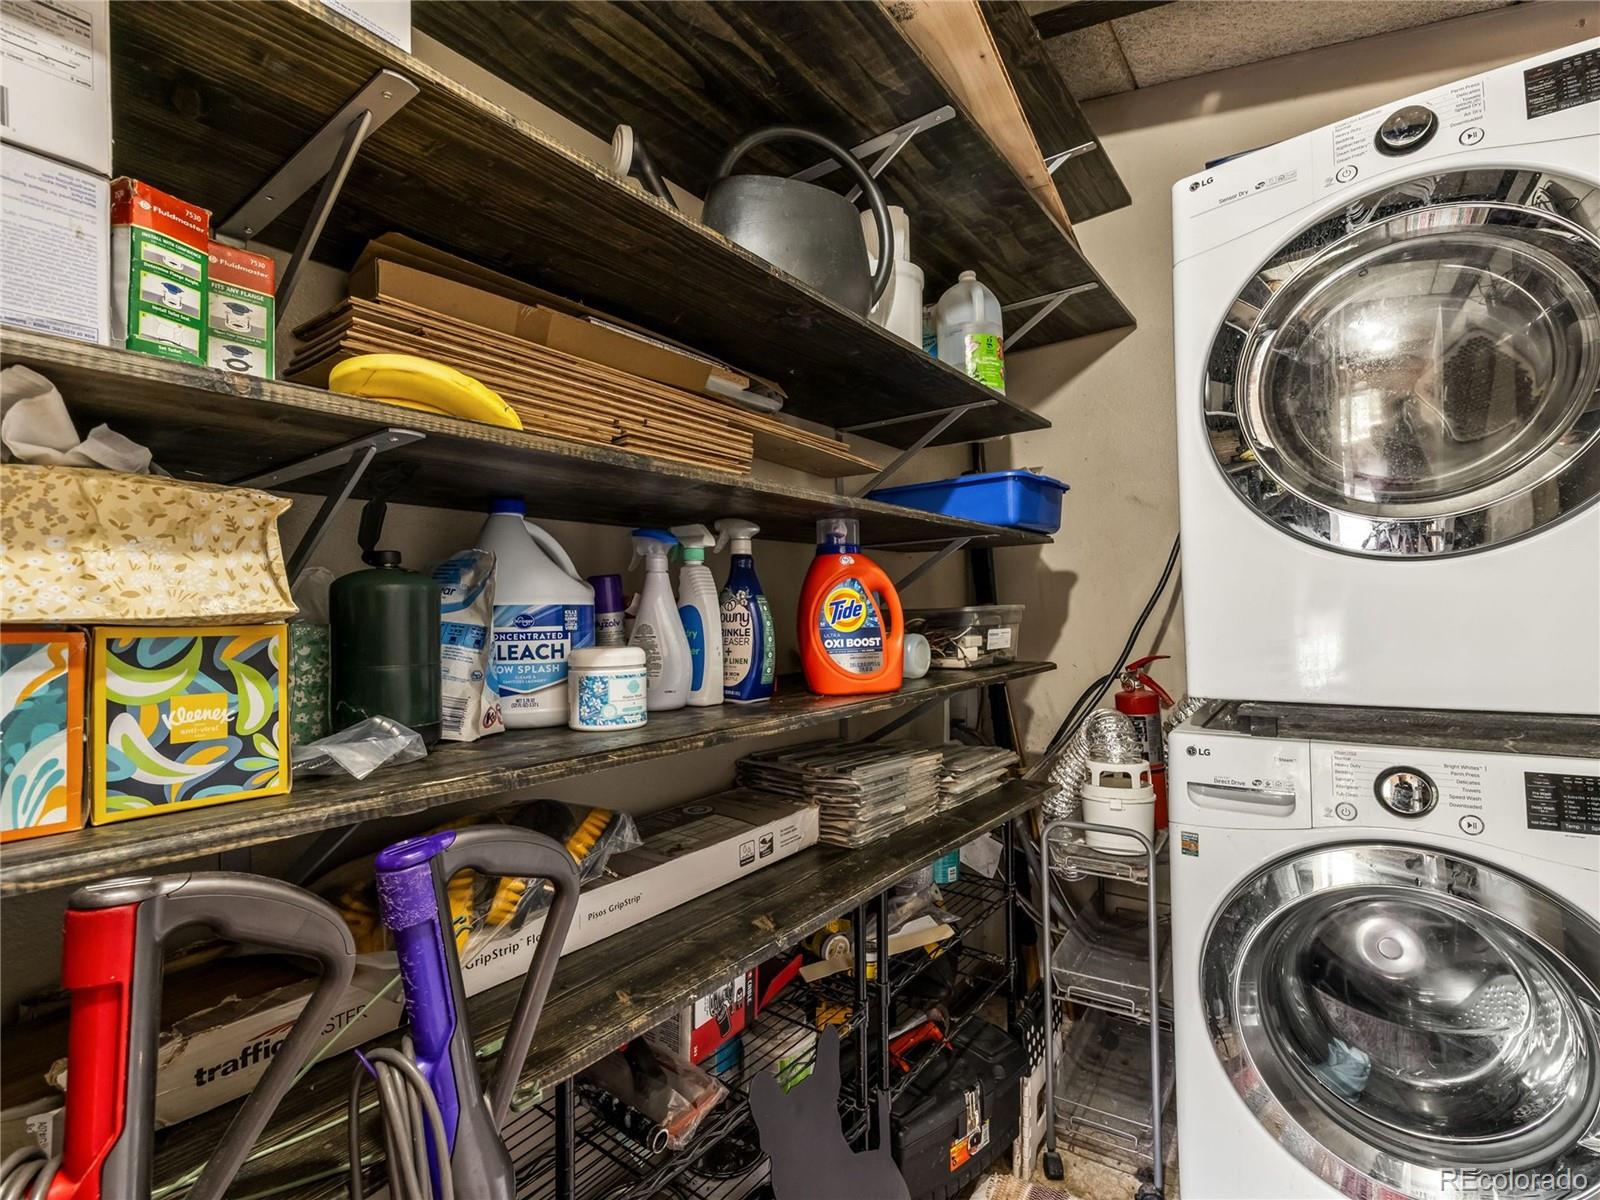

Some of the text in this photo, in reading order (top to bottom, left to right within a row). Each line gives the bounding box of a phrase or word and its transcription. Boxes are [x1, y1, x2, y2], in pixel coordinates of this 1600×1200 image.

[1201, 177, 1214, 187] LG
[1219, 190, 1249, 204] Sensor Dry
[153, 206, 205, 233] Fluidmaster
[185, 210, 202, 223] 7530
[220, 259, 269, 279] Fluidmaster
[251, 259, 266, 270] 7530
[211, 282, 225, 291] FITS
[226, 287, 240, 296] ANY
[241, 290, 265, 302] FLANGE
[830, 599, 863, 625] Tide
[721, 613, 750, 628] owny
[495, 633, 563, 641] ONCENTRATED
[722, 629, 751, 637] RINKLE
[723, 638, 750, 646] EASER
[824, 638, 882, 649] OXI BOOST
[497, 643, 565, 661] LEACH
[496, 665, 560, 675] OW SPLASH
[161, 707, 236, 730] Kleenex
[1199, 749, 1211, 757] LG
[587, 908, 607, 921] Pisos
[321, 1004, 368, 1036] STER
